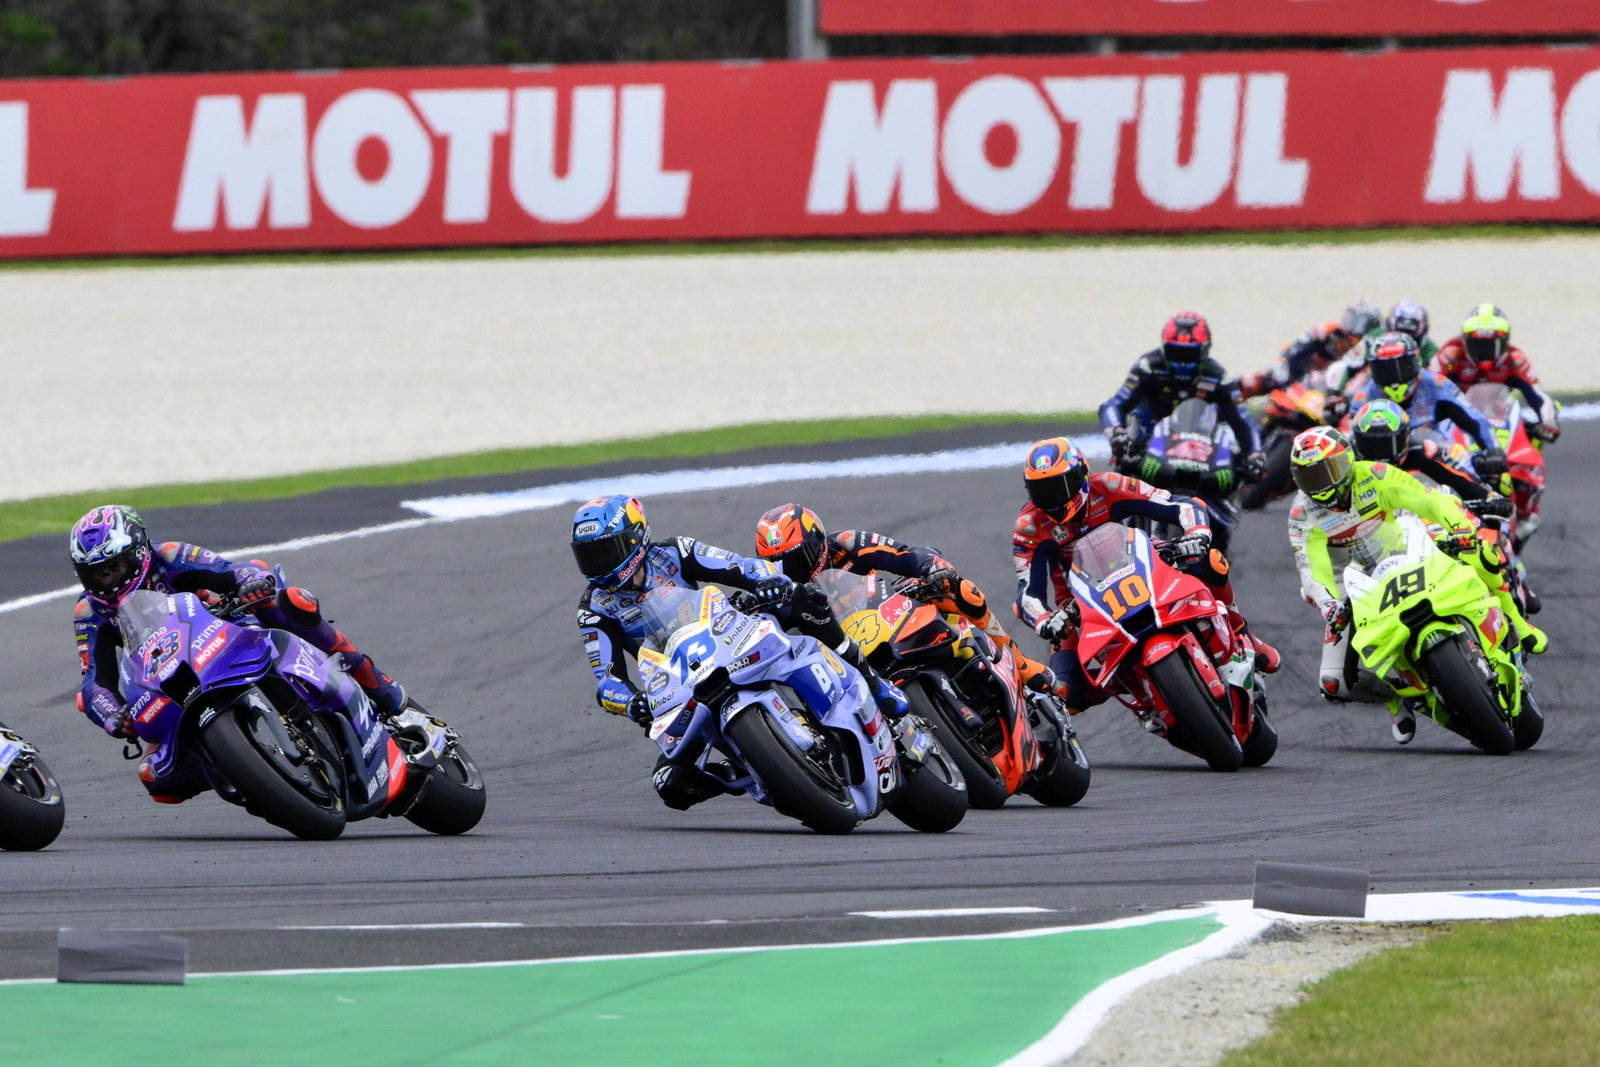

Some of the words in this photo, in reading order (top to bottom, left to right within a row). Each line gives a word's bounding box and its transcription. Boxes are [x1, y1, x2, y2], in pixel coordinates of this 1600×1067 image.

[172, 85, 692, 232] MOTUL
[805, 73, 1309, 215] MOTUL
[578, 524, 597, 535] SHOEI
[1105, 566, 1135, 586] Castrol
[1159, 578, 1181, 602] HONDA
[1379, 566, 1426, 614] 49
[1102, 574, 1151, 623] 10
[137, 625, 168, 659] prima
[191, 619, 224, 652] prima
[1085, 628, 1114, 639] HONDA
[195, 636, 226, 666] MOTUL
[725, 656, 751, 674] BOLD
[130, 691, 151, 719] prima
[142, 699, 165, 723] MOTUL
